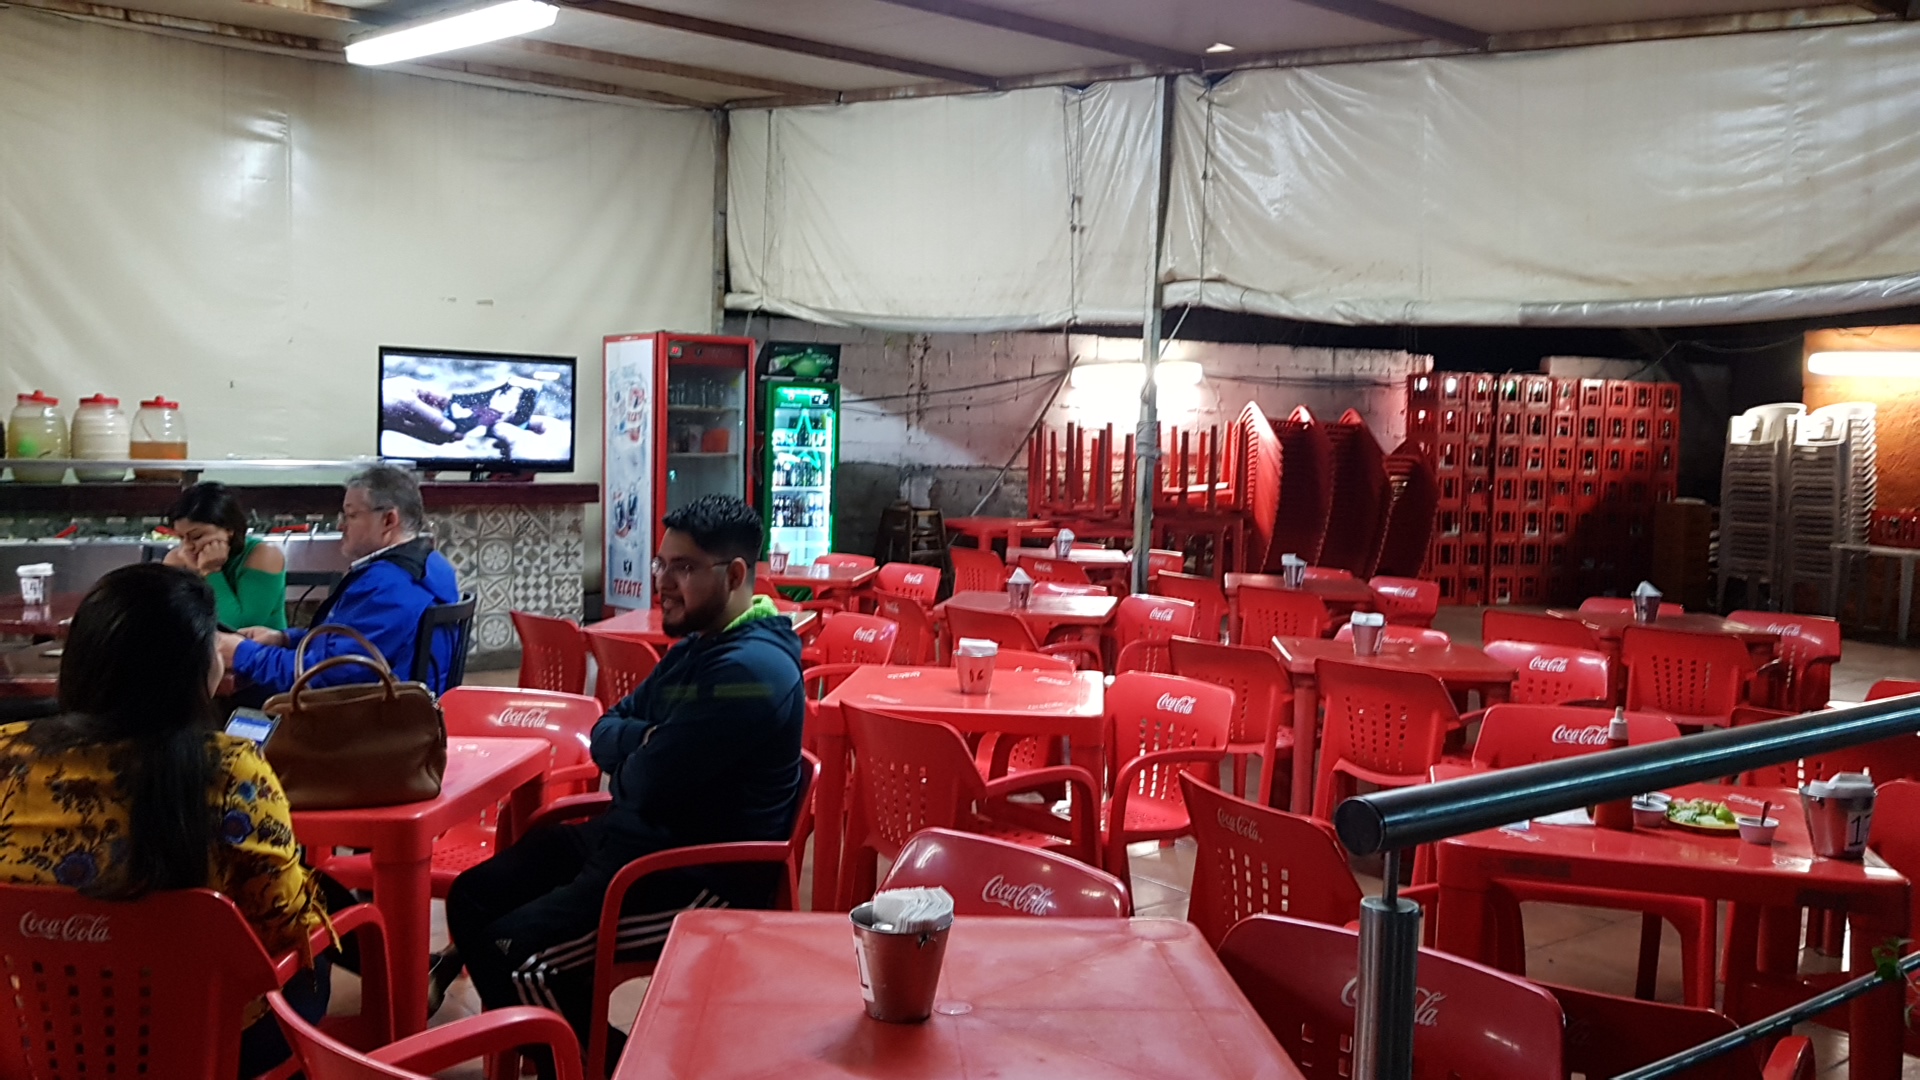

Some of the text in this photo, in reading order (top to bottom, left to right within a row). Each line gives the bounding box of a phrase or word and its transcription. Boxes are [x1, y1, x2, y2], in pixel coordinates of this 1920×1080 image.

[614, 579, 642, 598] TECATE
[1766, 623, 1801, 637] Coca-Cola
[1529, 655, 1570, 673] Coca-Cola
[1156, 692, 1197, 714] Coca-Cola
[498, 707, 549, 728] Coca-Cola
[1552, 724, 1609, 745] Coca-Cola
[1217, 807, 1259, 841] Coca-Cola
[982, 874, 1054, 916] Coca-Cola
[20, 910, 111, 942] Coca-Cola
